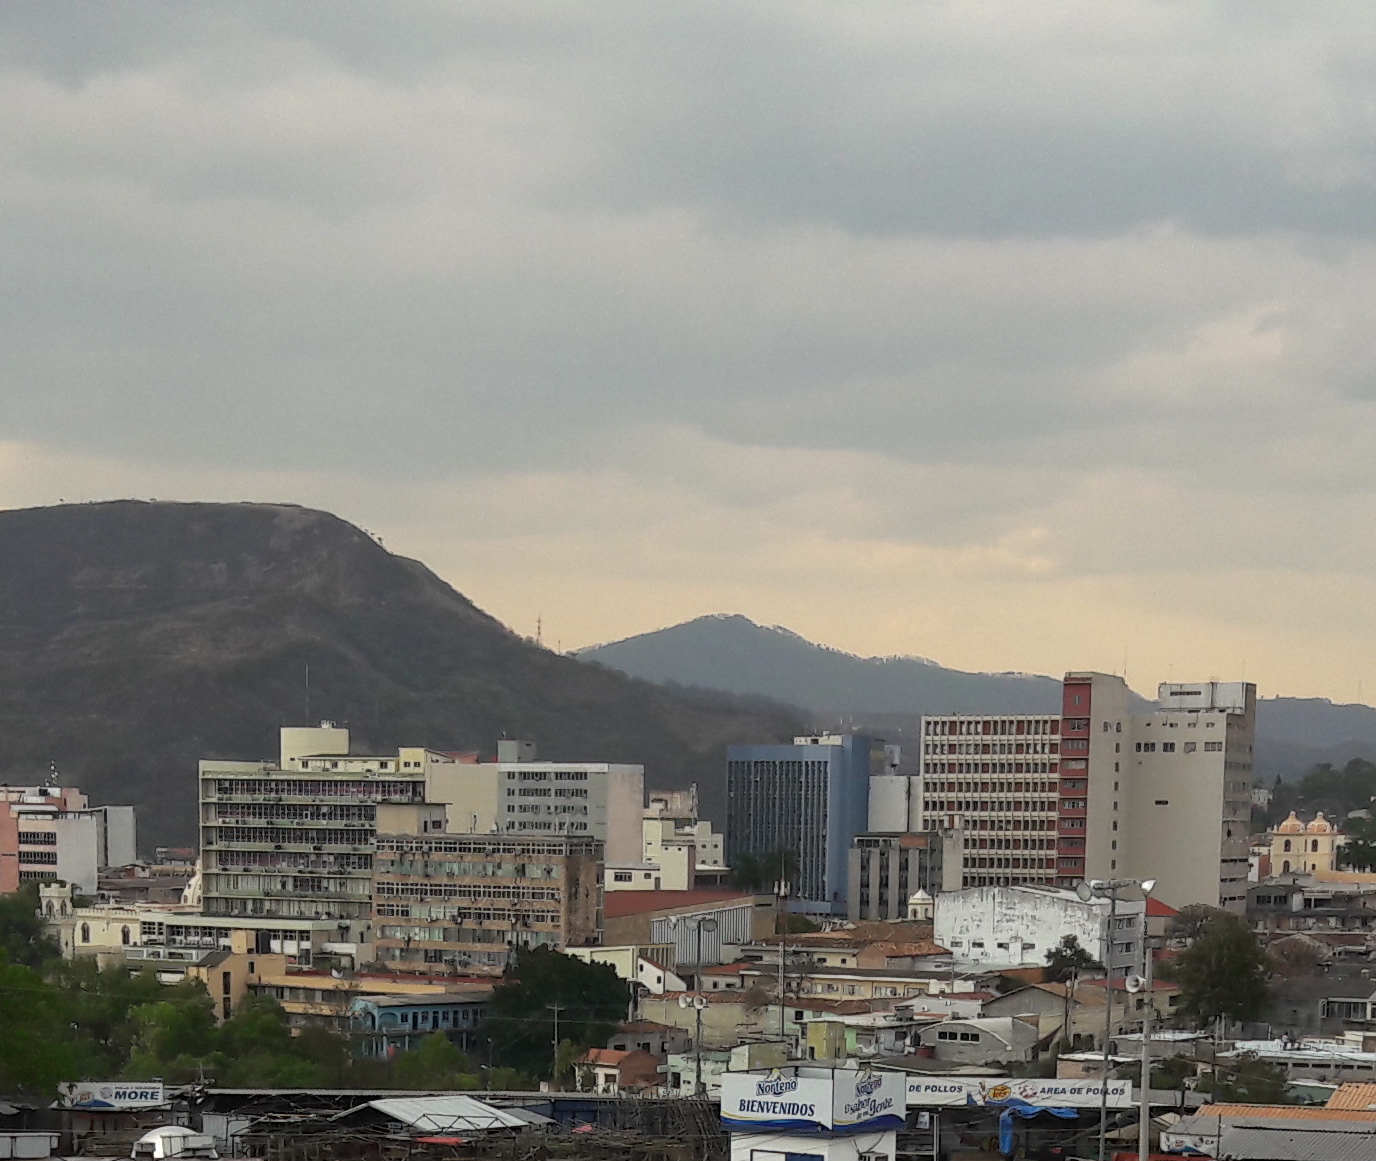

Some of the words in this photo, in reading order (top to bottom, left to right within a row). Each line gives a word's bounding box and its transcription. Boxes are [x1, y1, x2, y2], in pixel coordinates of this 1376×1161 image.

[908, 1085, 921, 1093] DE
[924, 1085, 963, 1094] POLLOS
[1086, 1087, 1126, 1096] POLLOS
[114, 1091, 159, 1100] MORE
[739, 1099, 815, 1117] BIENVENIDOS
